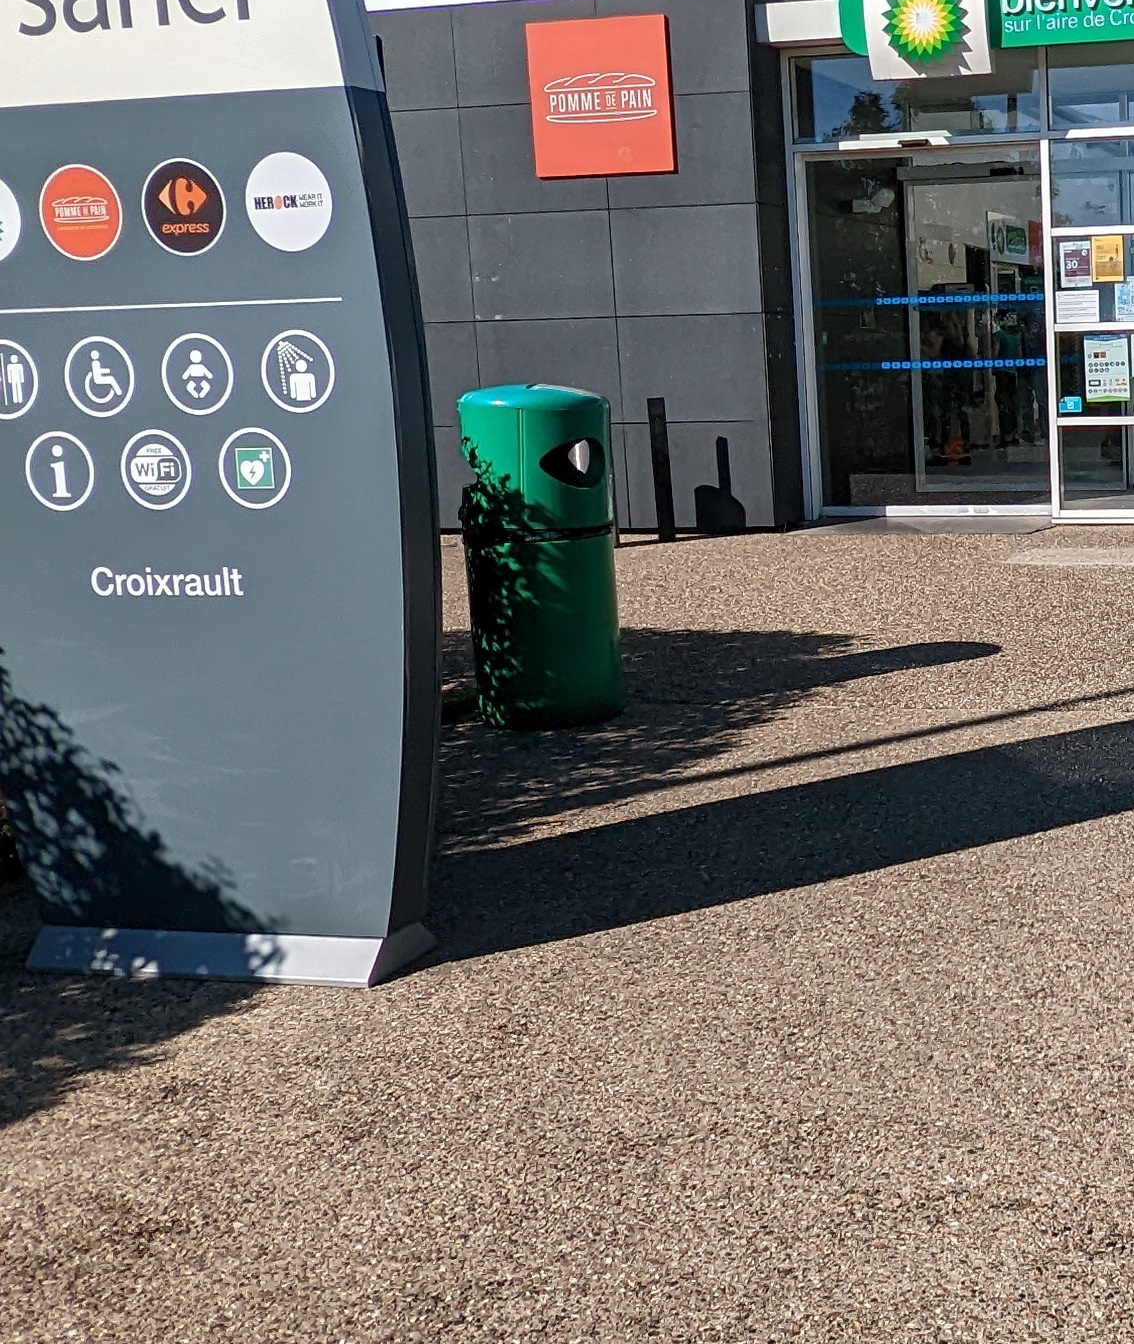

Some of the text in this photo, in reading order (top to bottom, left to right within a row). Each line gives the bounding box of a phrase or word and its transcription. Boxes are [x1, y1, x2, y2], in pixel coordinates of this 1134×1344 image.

[1004, 18, 1031, 33] sur
[1036, 13, 1078, 30] l'aire
[1083, 11, 1105, 28] de
[550, 89, 652, 113] POMME DE PAIN
[254, 195, 298, 210] HEROCK
[162, 223, 210, 236] express
[1066, 260, 1078, 269] 30
[91, 567, 245, 596] Croixrault
